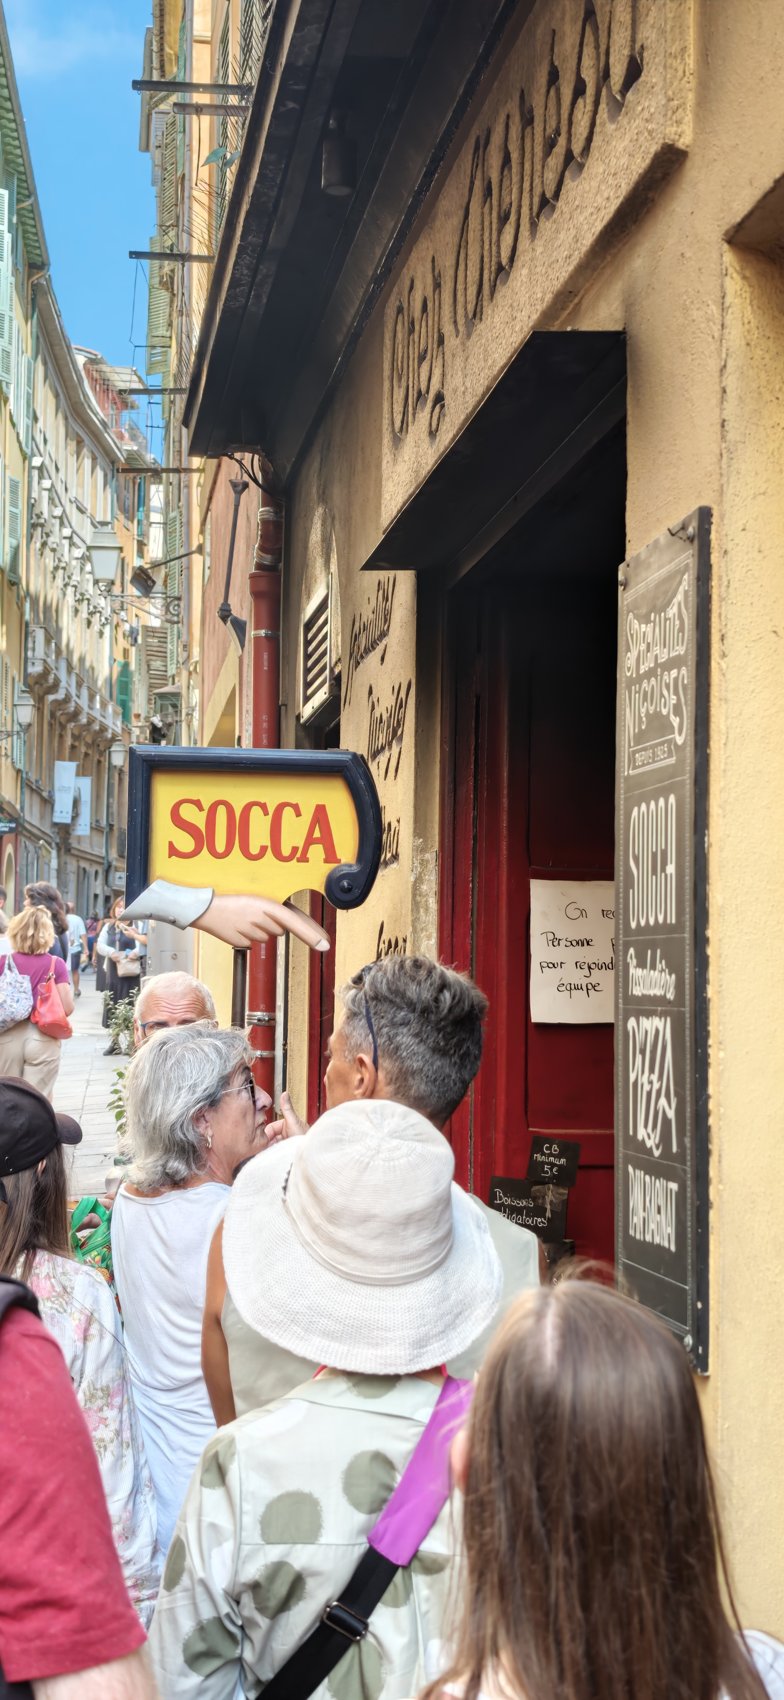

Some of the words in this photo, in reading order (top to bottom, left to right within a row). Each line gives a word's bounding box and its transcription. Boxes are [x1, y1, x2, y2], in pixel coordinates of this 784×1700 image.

[391, 255, 446, 447] Chez
[167, 797, 341, 865] SOCCA
[629, 793, 677, 930] SOCCA
[564, 901, 588, 920] On
[540, 931, 595, 948] Personne
[539, 961, 566, 974] pour
[556, 977, 603, 999] équipe
[493, 1188, 534, 1207] Boissons
[501, 1206, 548, 1227] bligatoires
[627, 1164, 679, 1253] PAN-BAGNAT
